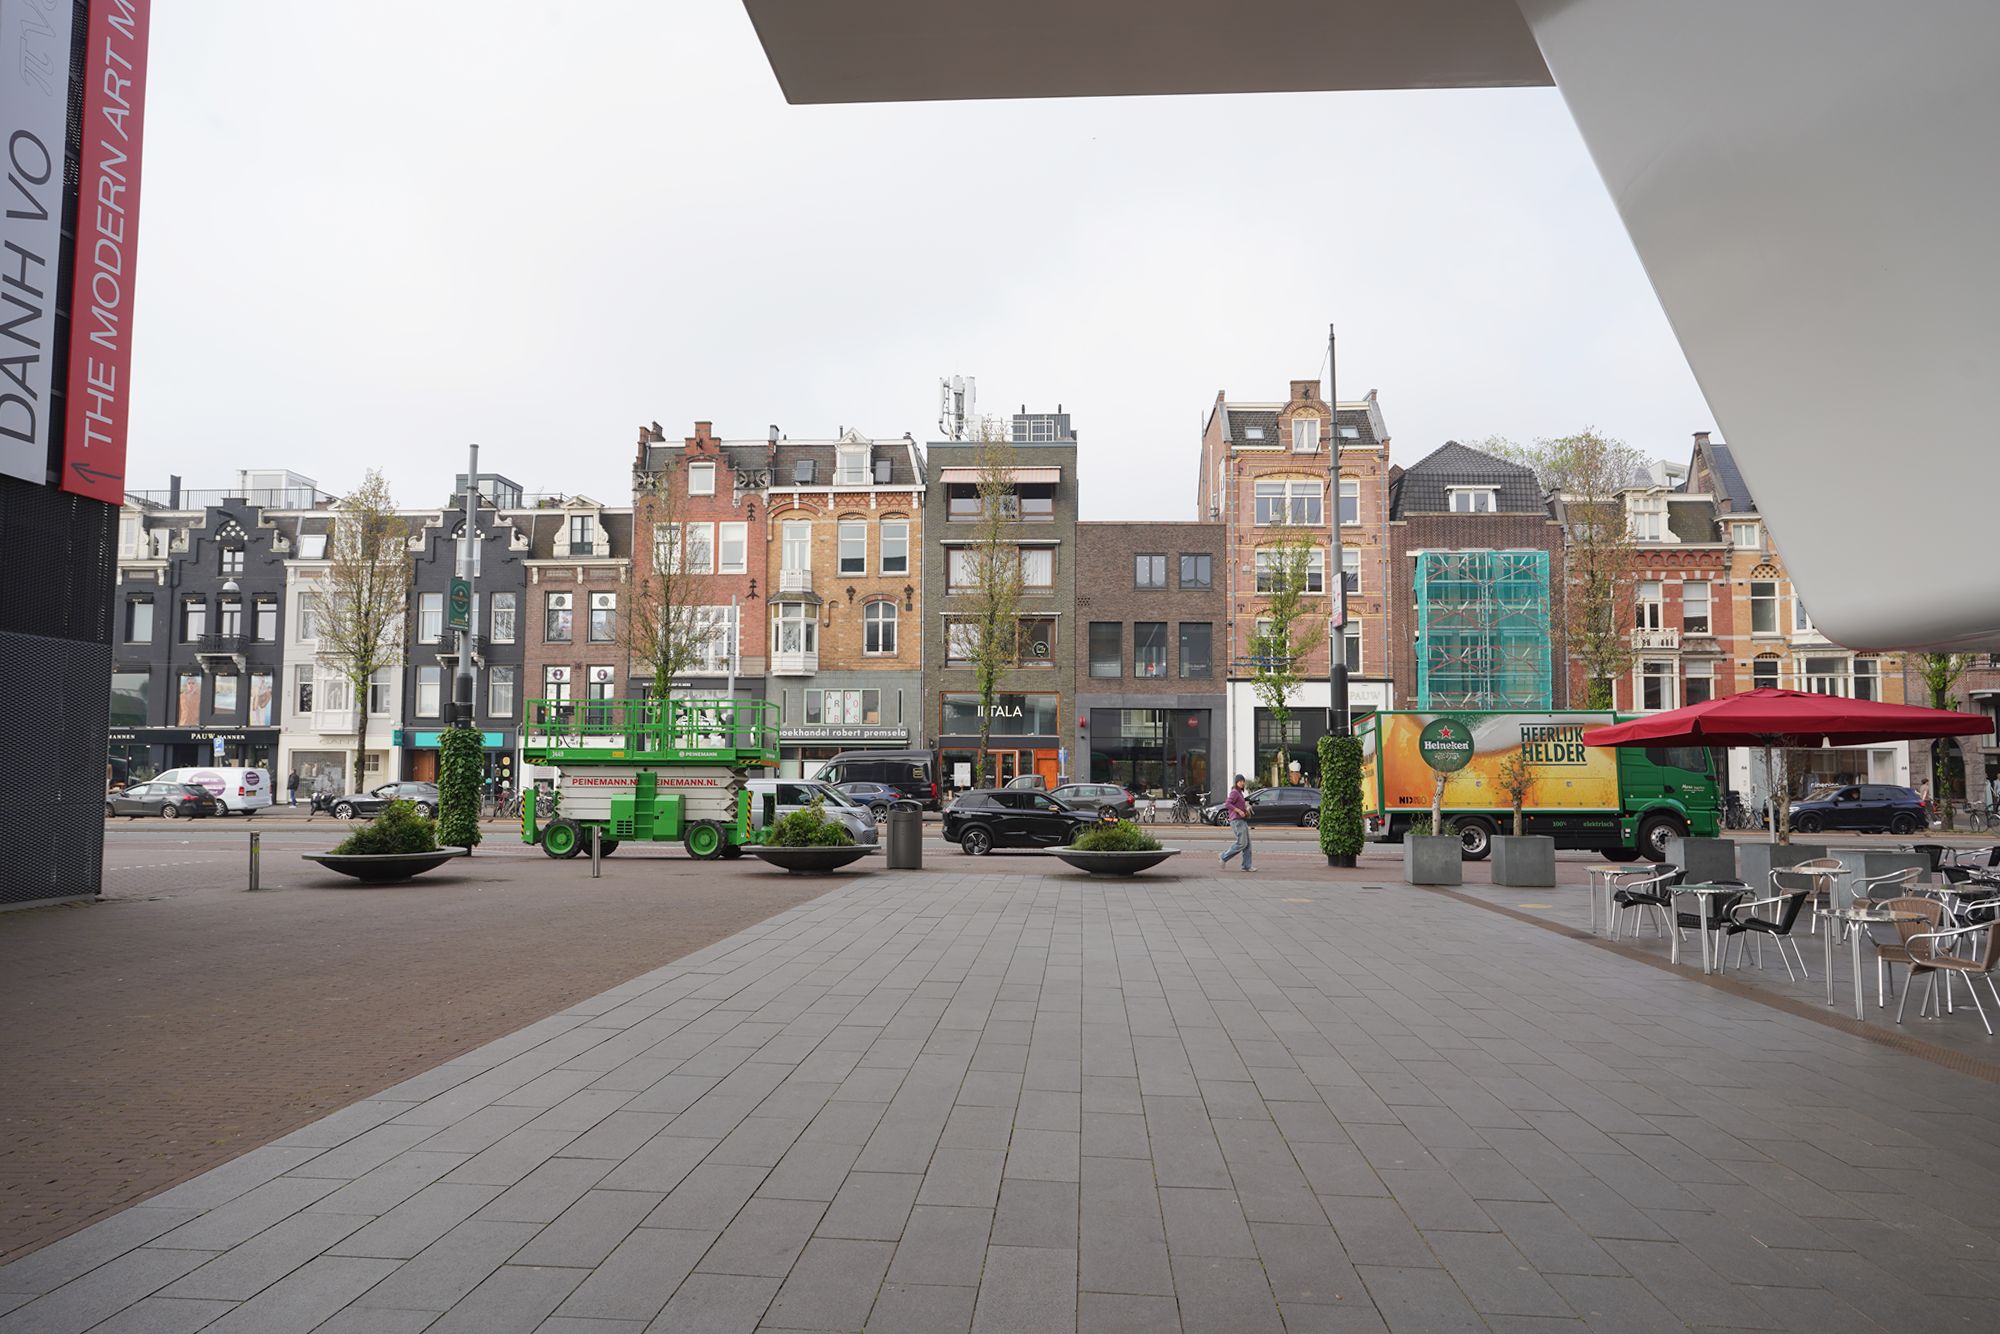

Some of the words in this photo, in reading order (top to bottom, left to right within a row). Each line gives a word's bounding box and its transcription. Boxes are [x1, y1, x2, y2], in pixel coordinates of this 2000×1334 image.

[102, 36, 132, 142] ART
[6, 130, 51, 220] VO
[90, 140, 128, 350] MODERN
[0, 240, 46, 444] DANH
[84, 357, 116, 447] THE
[977, 705, 1023, 717] IITALA
[832, 728, 861, 737] robert
[864, 728, 907, 738] premsela
[1521, 727, 1583, 742] HEERLIJK
[1424, 740, 1469, 750] Heineken
[1522, 743, 1586, 762] HELDER
[572, 778, 638, 786] PEINEMANN.N
[656, 778, 719, 786] EINEMANN.NL
